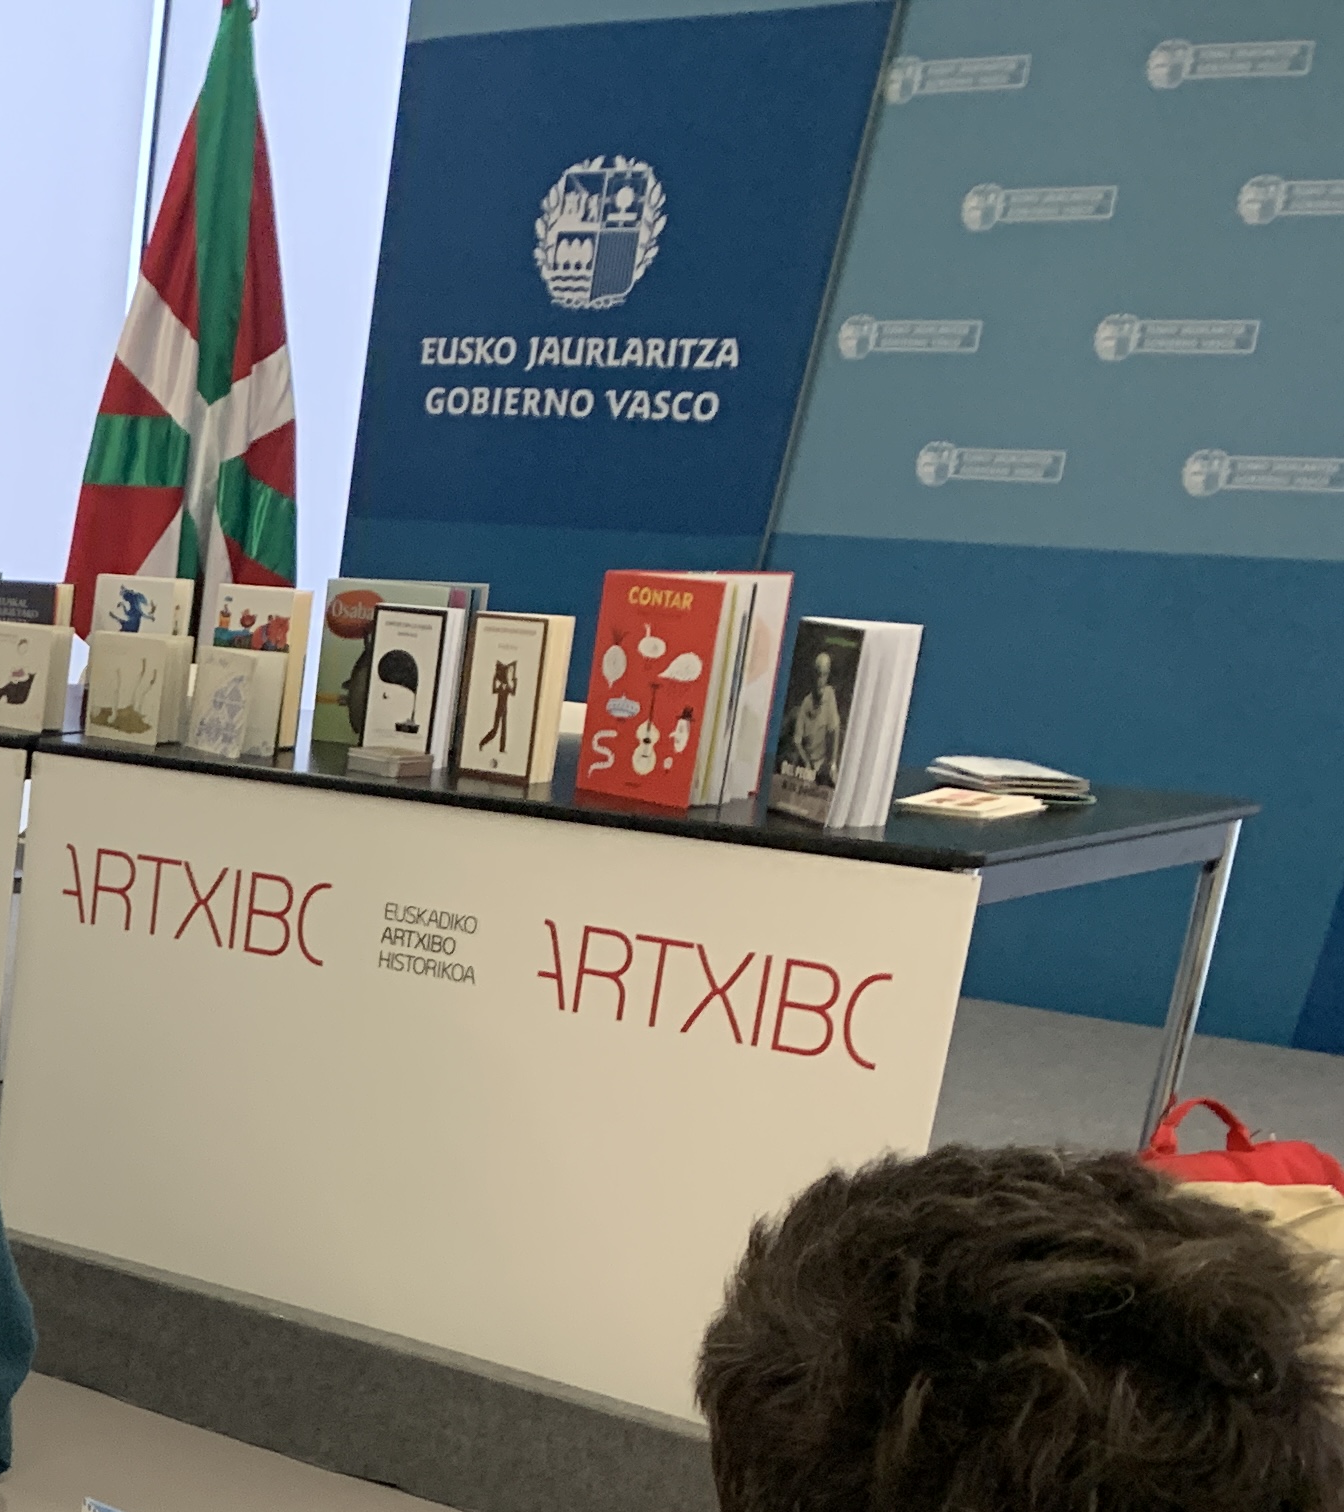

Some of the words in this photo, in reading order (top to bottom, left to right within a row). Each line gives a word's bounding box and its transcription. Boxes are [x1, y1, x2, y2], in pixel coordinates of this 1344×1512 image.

[420, 336, 517, 367] EUSKO
[524, 336, 739, 372] JAURLARITZA
[424, 386, 594, 418] GOBIERNO
[605, 389, 721, 422] VASCO
[627, 585, 694, 610] CONTAR
[384, 902, 478, 935] EUSKADIKO
[380, 926, 457, 956] ARTXIBO
[377, 950, 476, 985] HISTORIKOA
